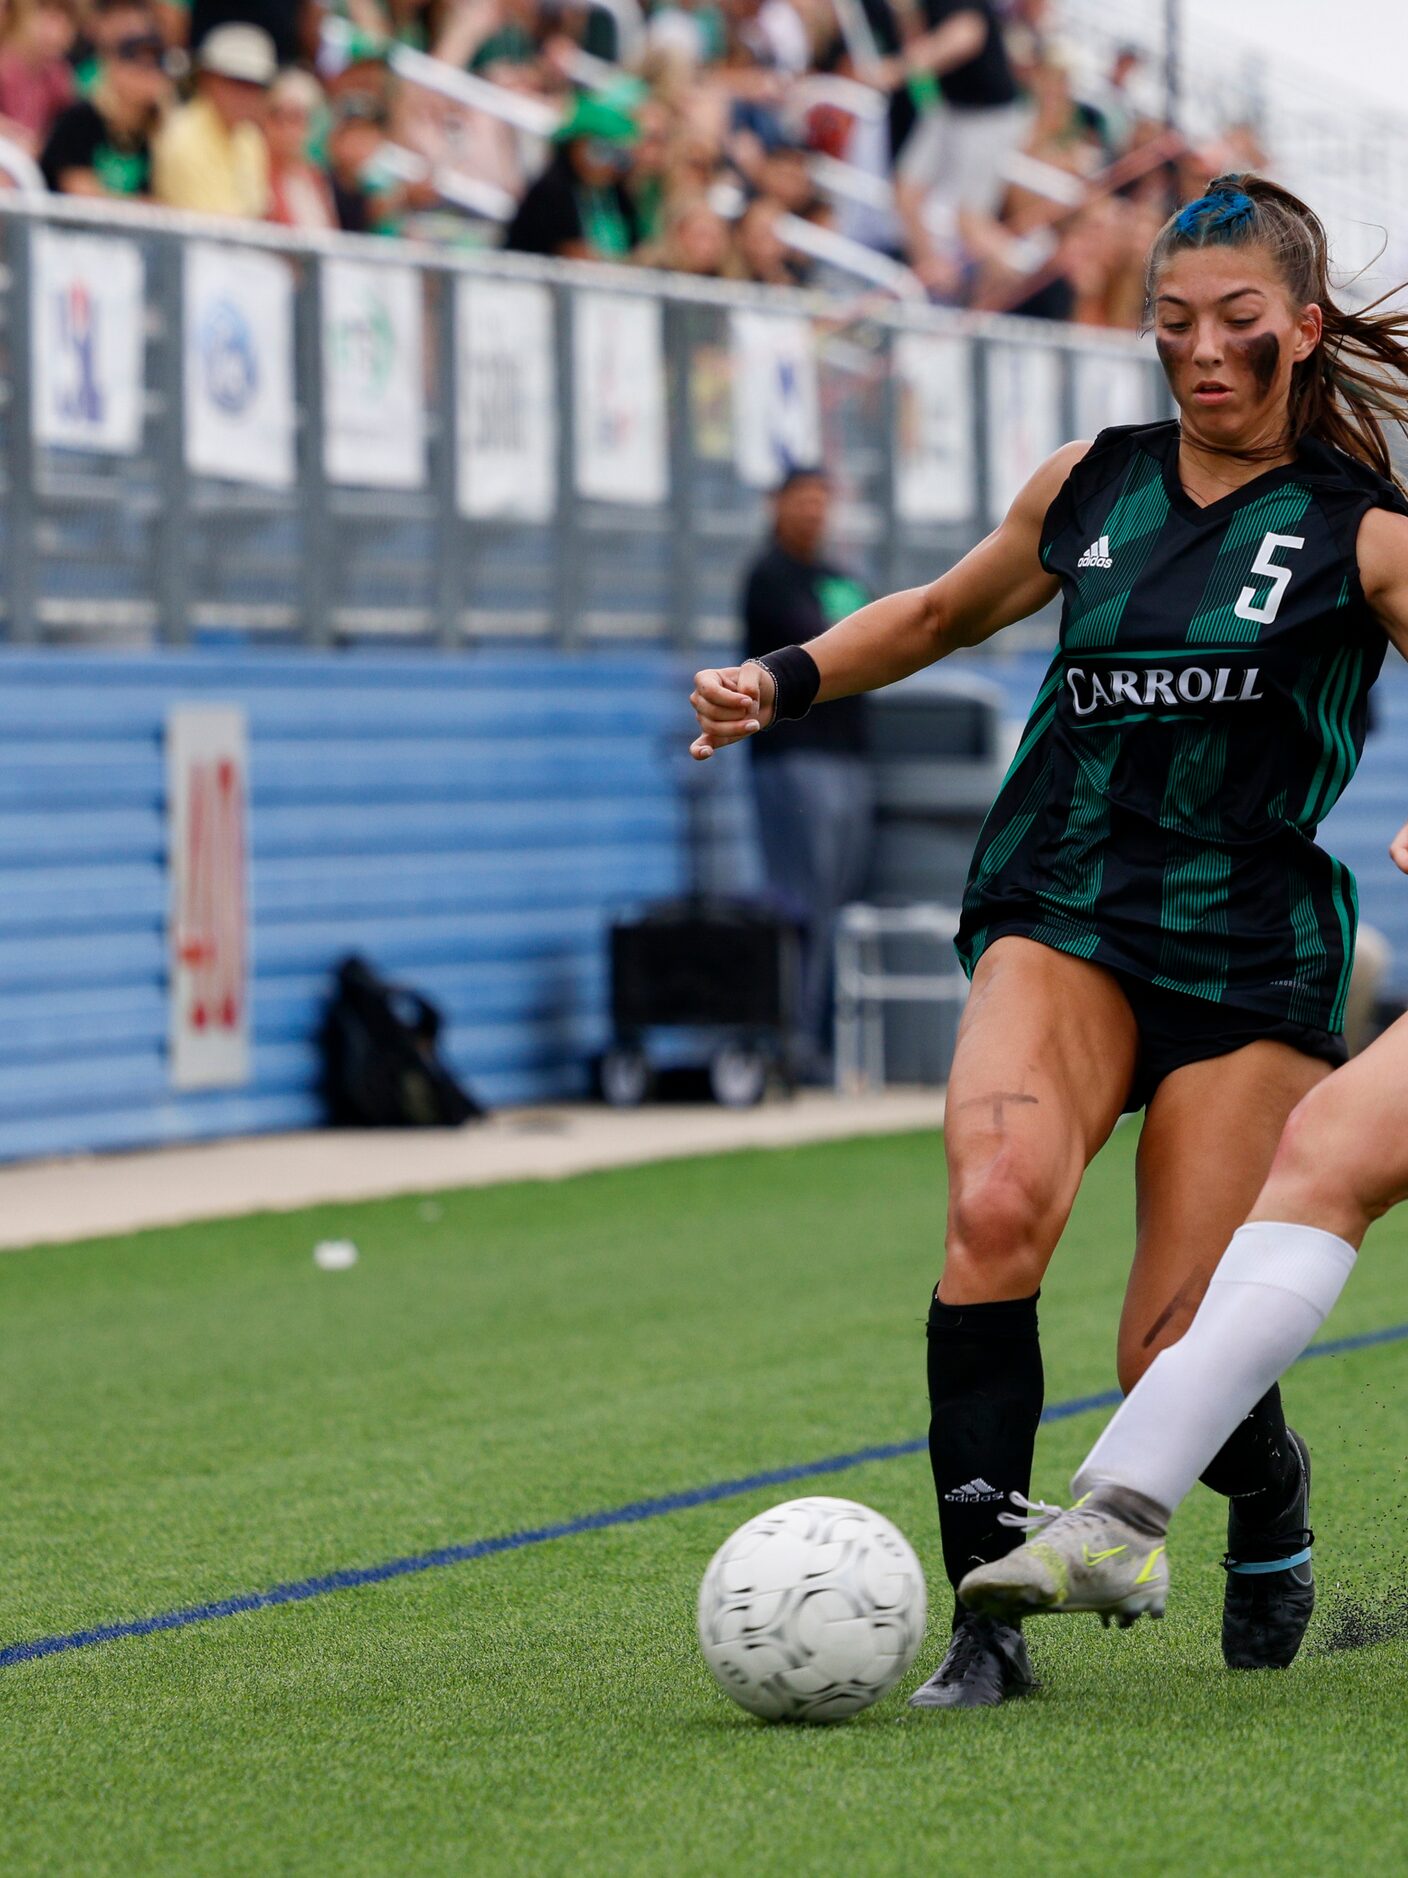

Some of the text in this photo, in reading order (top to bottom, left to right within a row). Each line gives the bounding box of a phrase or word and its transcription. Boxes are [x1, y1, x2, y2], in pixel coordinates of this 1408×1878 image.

[1077, 555, 1113, 568] adidas
[1234, 531, 1305, 625] 5
[1066, 666, 1265, 716] CARROLL
[944, 1491, 1004, 1503] adidas
